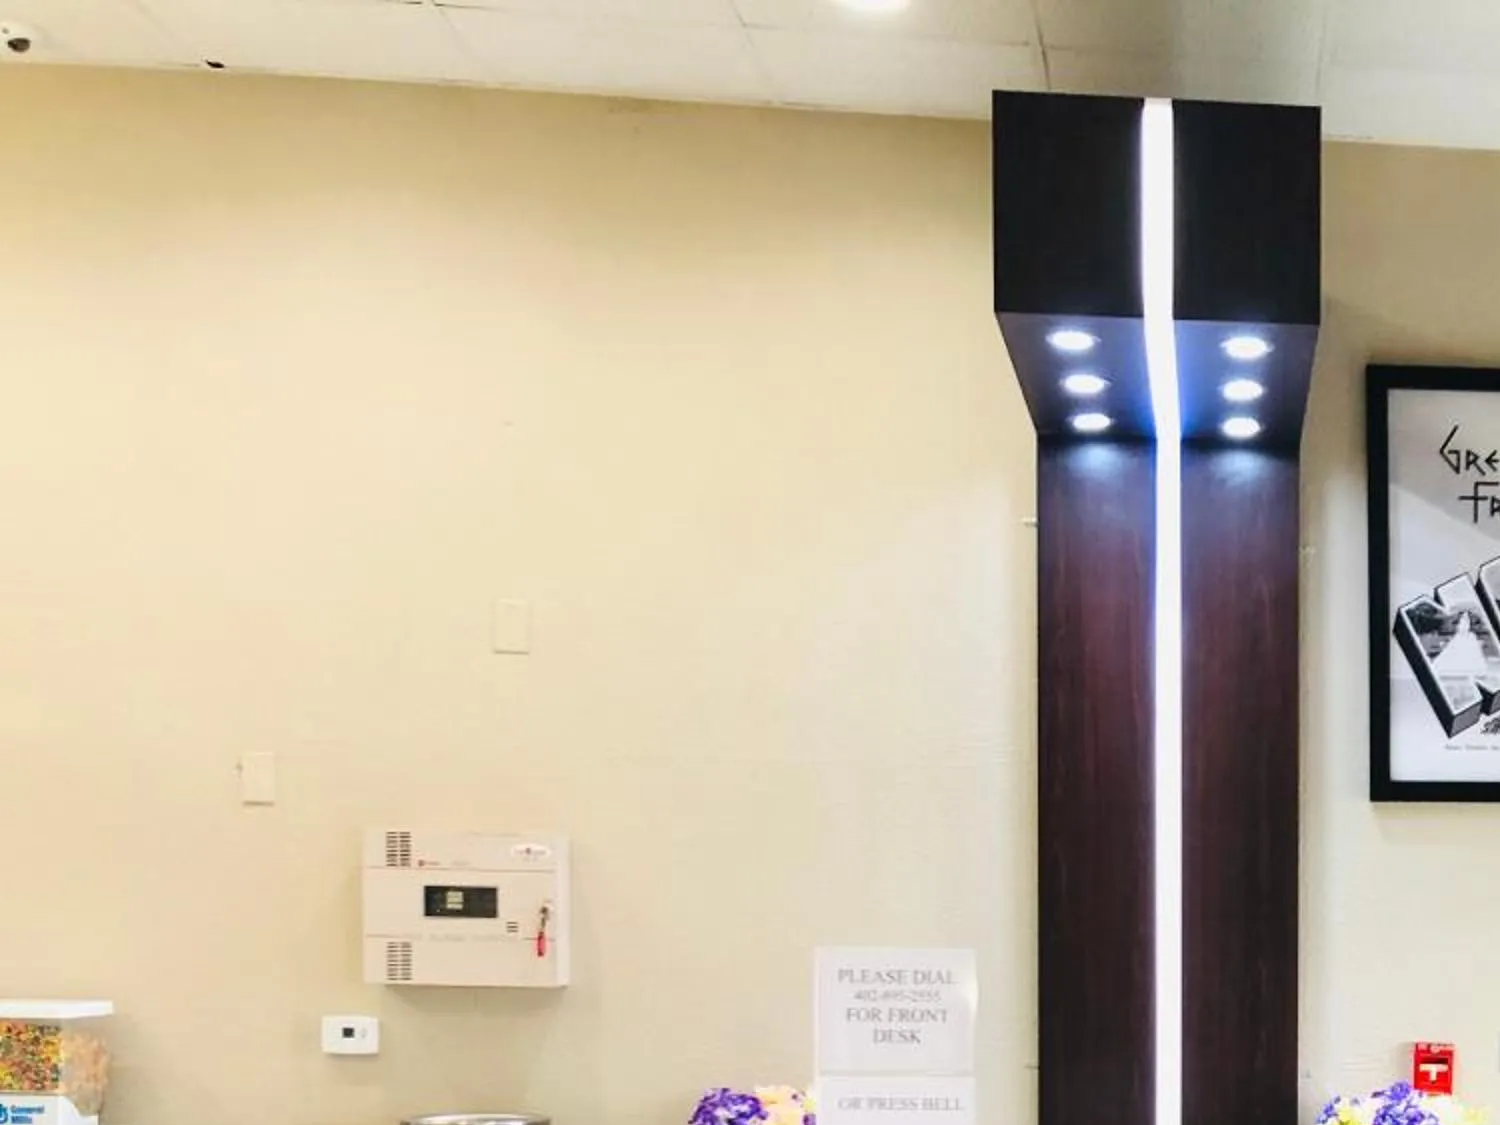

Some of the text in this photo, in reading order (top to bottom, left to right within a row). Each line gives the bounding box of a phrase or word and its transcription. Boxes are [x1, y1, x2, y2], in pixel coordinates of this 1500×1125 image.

[837, 968, 958, 985] PLEASE DIAL
[846, 1007, 948, 1024] FOR FRONT
[873, 1028, 922, 1044] DESK
